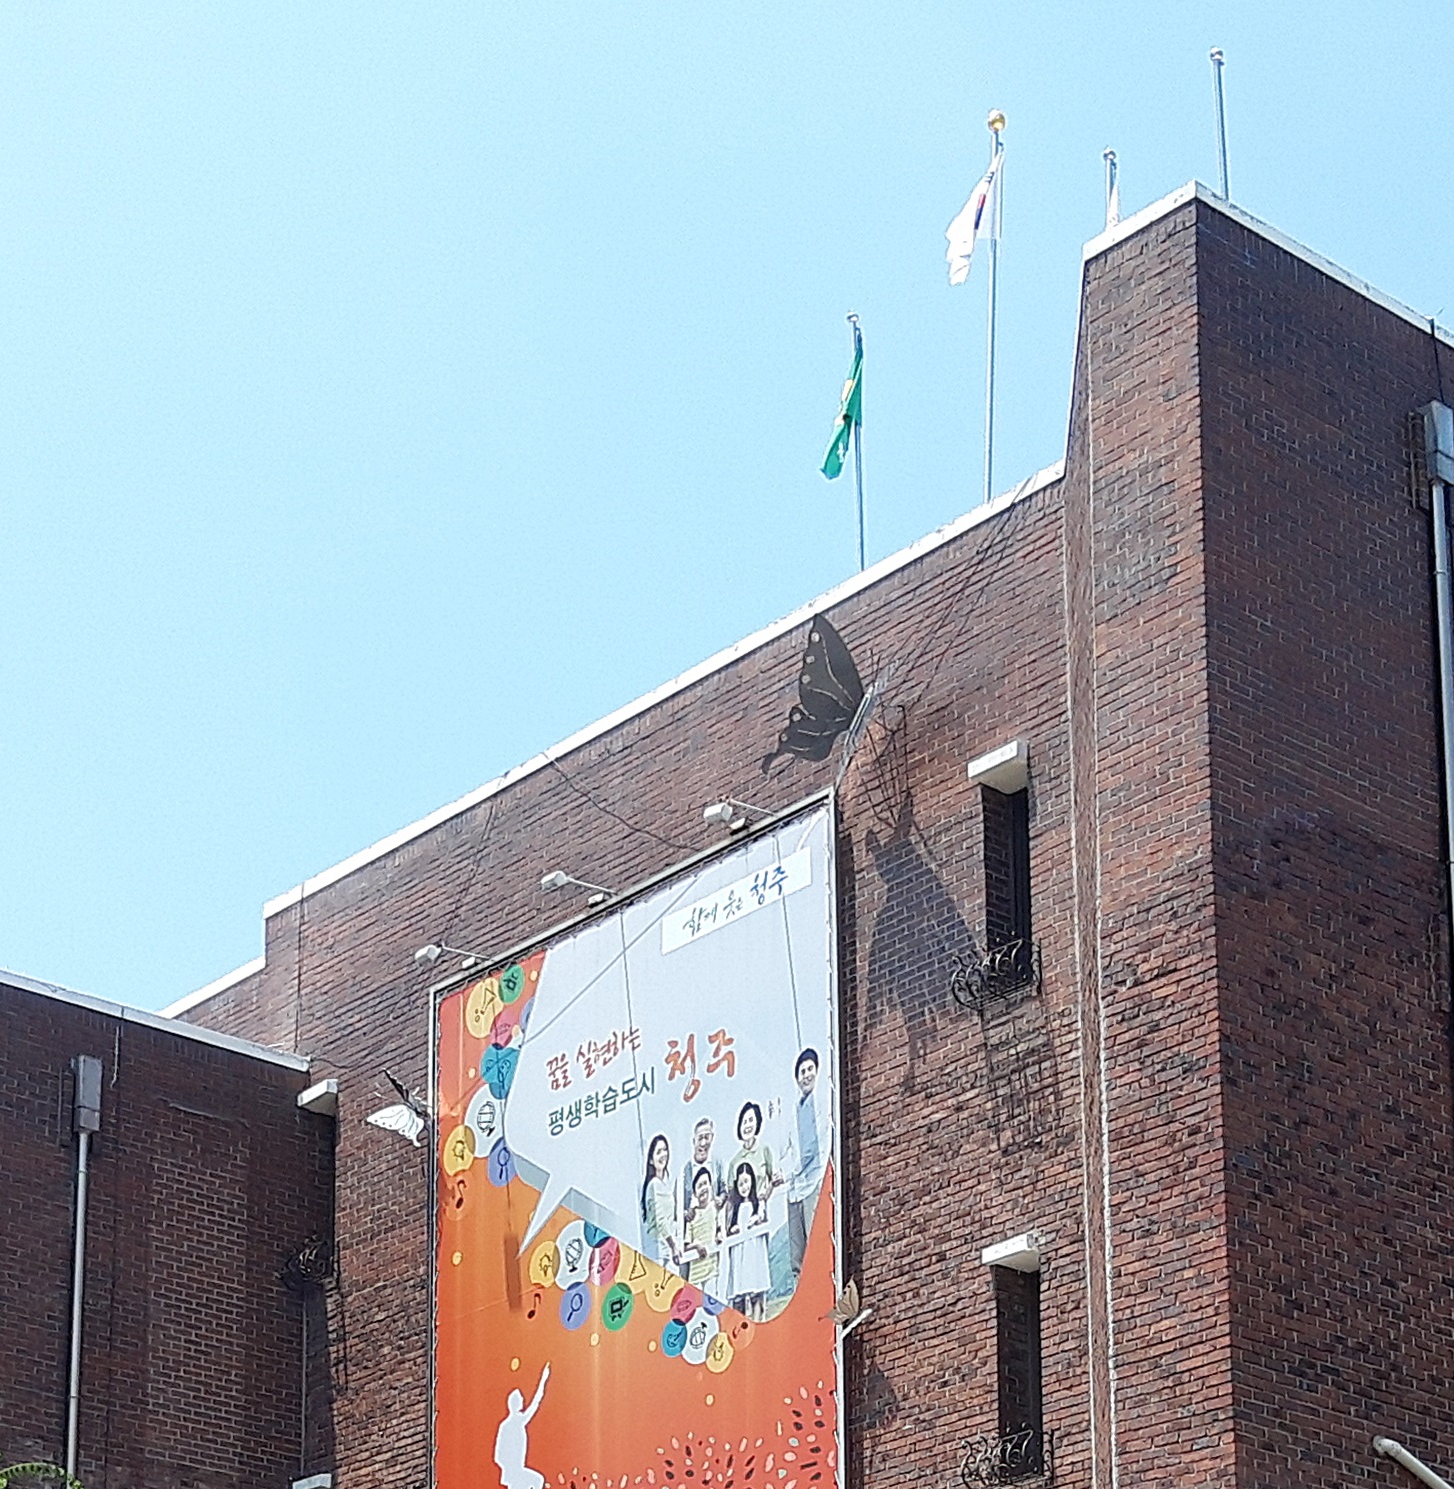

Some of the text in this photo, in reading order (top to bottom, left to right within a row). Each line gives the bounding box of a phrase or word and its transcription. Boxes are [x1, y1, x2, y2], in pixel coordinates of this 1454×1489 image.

[682, 903, 718, 937] 함께
[750, 865, 789, 905] 청주
[546, 1026, 641, 1091] 꿈을 실현하는
[664, 1029, 735, 1102] 청주
[548, 1066, 655, 1136] 평생학습도시
